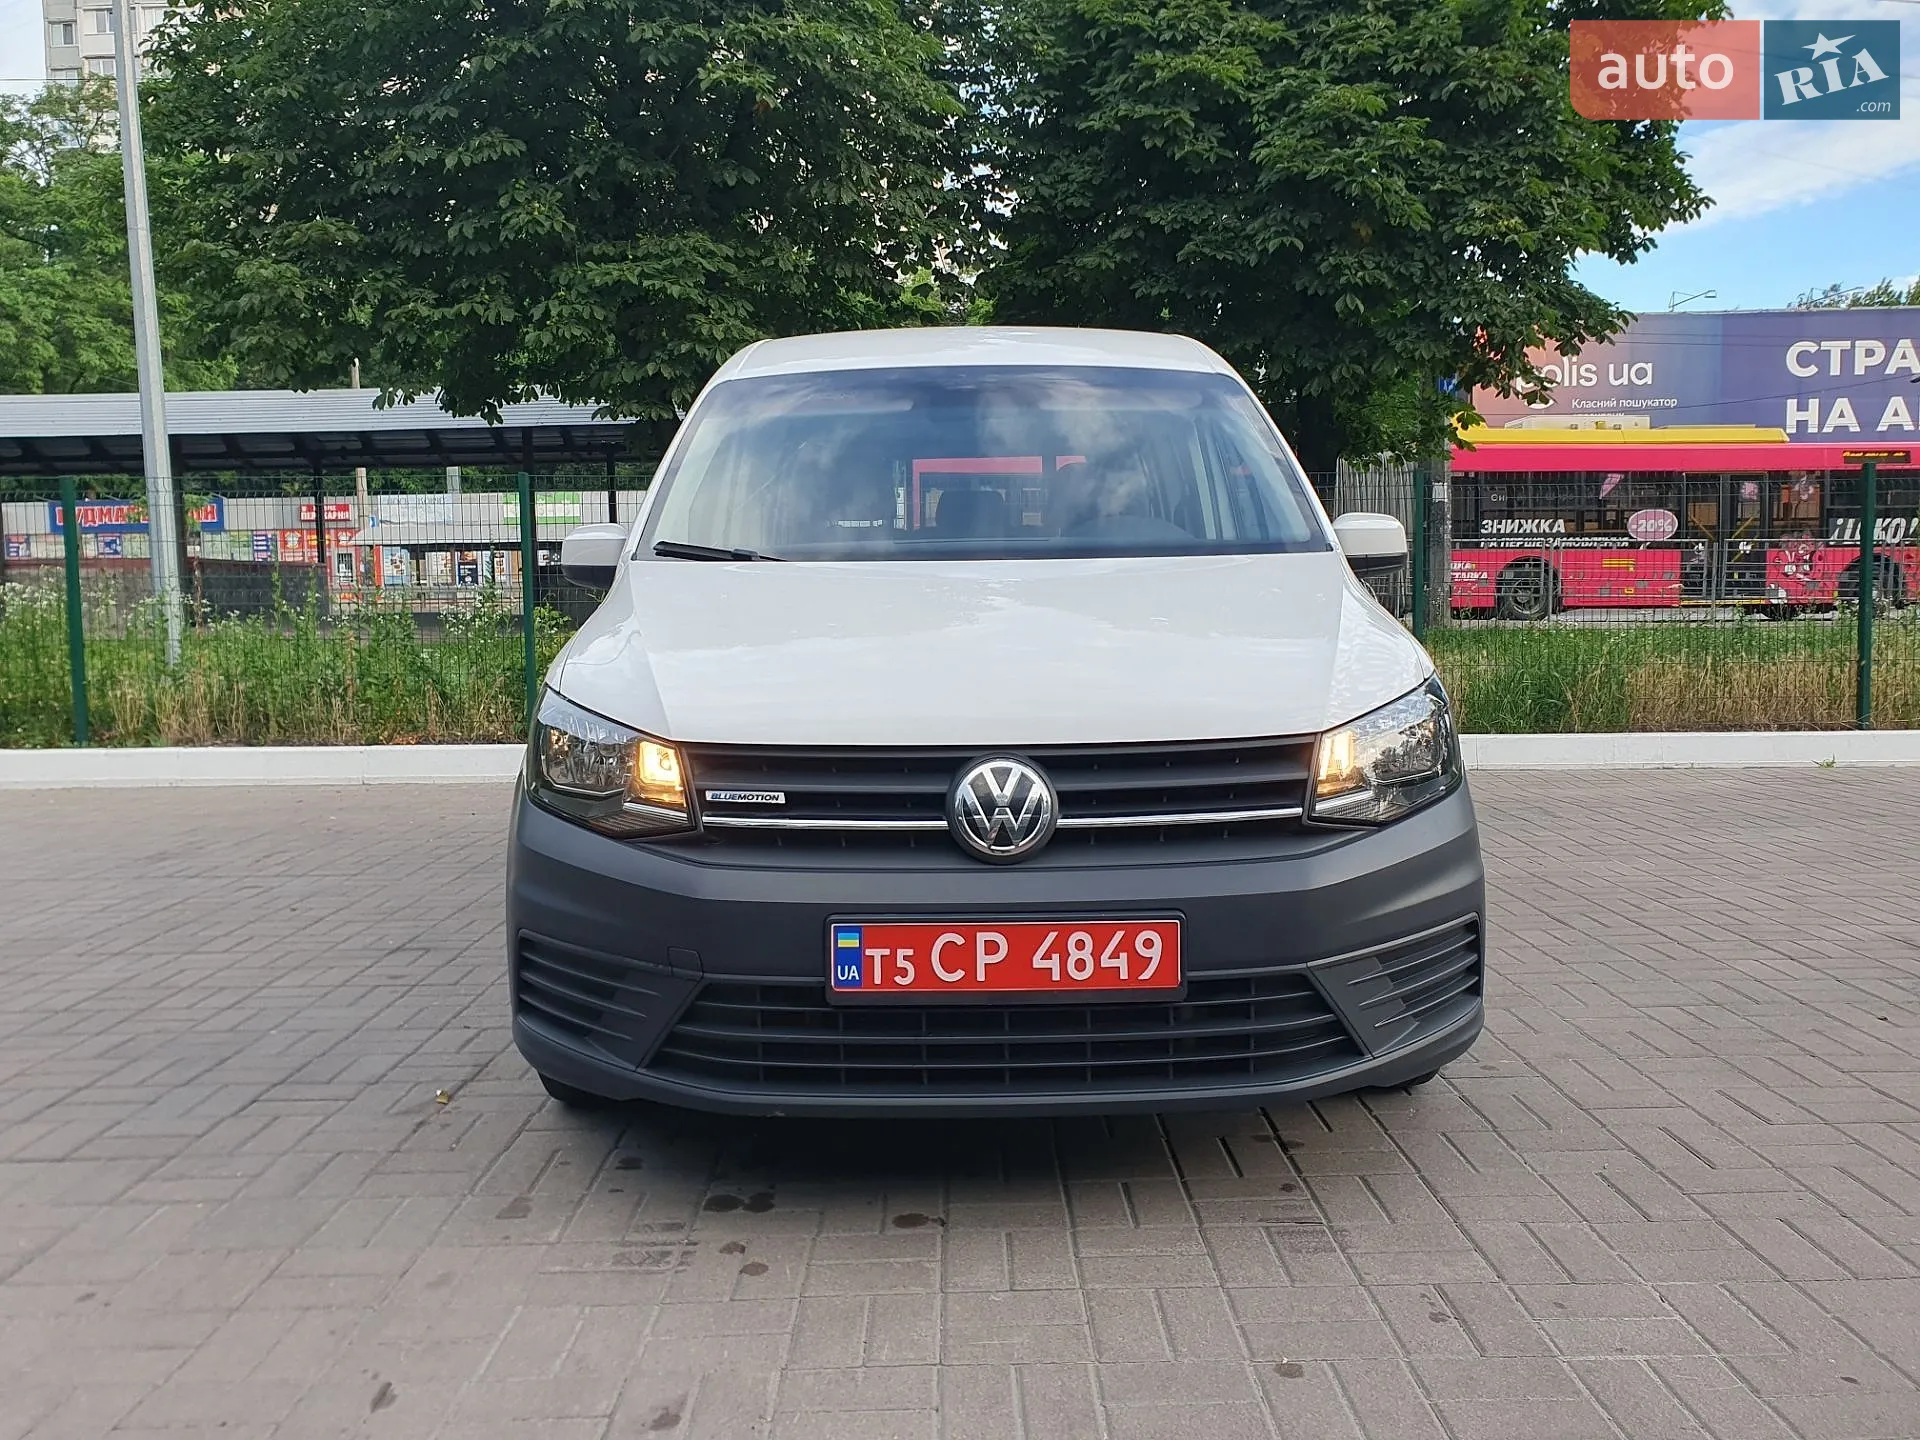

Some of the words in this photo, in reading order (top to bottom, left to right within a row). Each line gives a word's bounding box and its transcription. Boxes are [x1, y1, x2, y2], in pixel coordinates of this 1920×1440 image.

[1786, 339, 1920, 377] СТРА
[1608, 362, 1653, 386] ua
[1571, 398, 1617, 409] Класний
[1619, 398, 1678, 409] пошукатор
[1786, 398, 1861, 434] НА
[1876, 396, 1920, 432] А
[1480, 518, 1566, 534] ЗНИЖКА
[1631, 519, 1673, 532] -20%
[711, 793, 780, 802] BLUEMOTION
[837, 964, 860, 981] UA
[865, 948, 915, 986] T5
[931, 931, 1009, 982] CP
[1032, 930, 1163, 982] 4849
